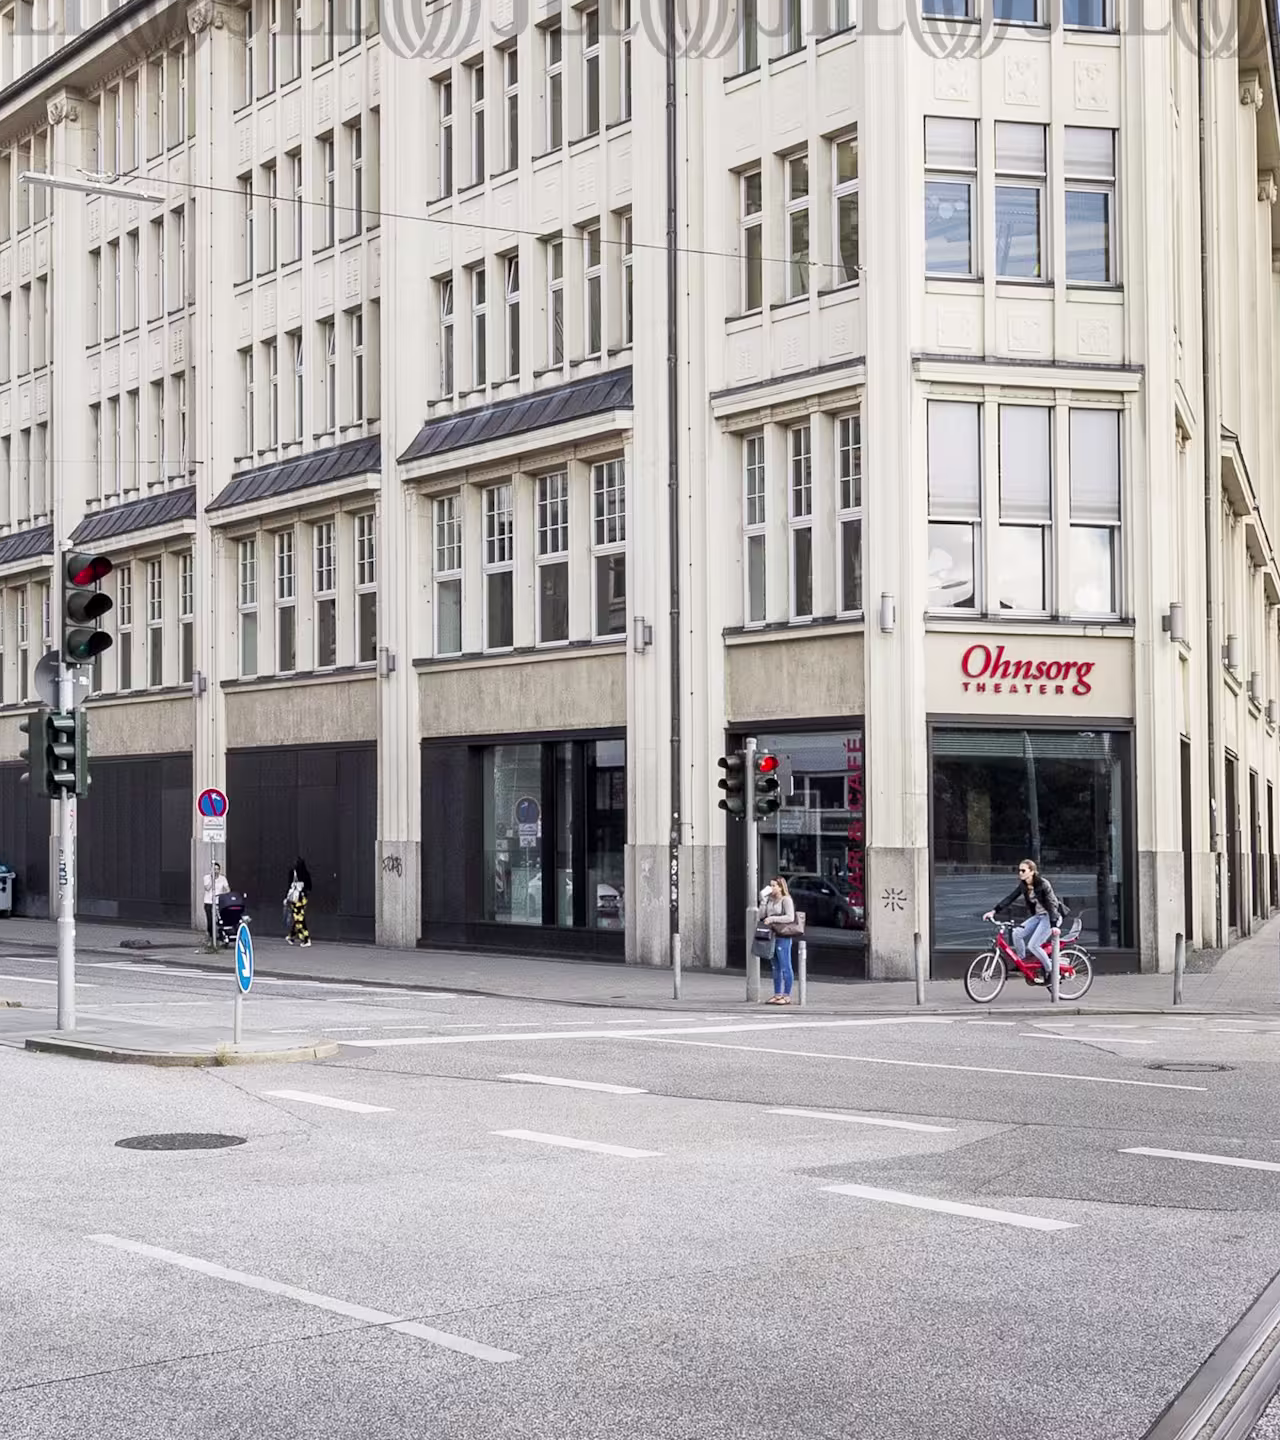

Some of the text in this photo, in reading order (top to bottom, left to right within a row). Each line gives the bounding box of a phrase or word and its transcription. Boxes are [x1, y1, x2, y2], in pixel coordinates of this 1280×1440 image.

[961, 644, 1096, 696] Ohnsorg
[962, 682, 1065, 695] THEATER
[847, 851, 863, 908] BAR
